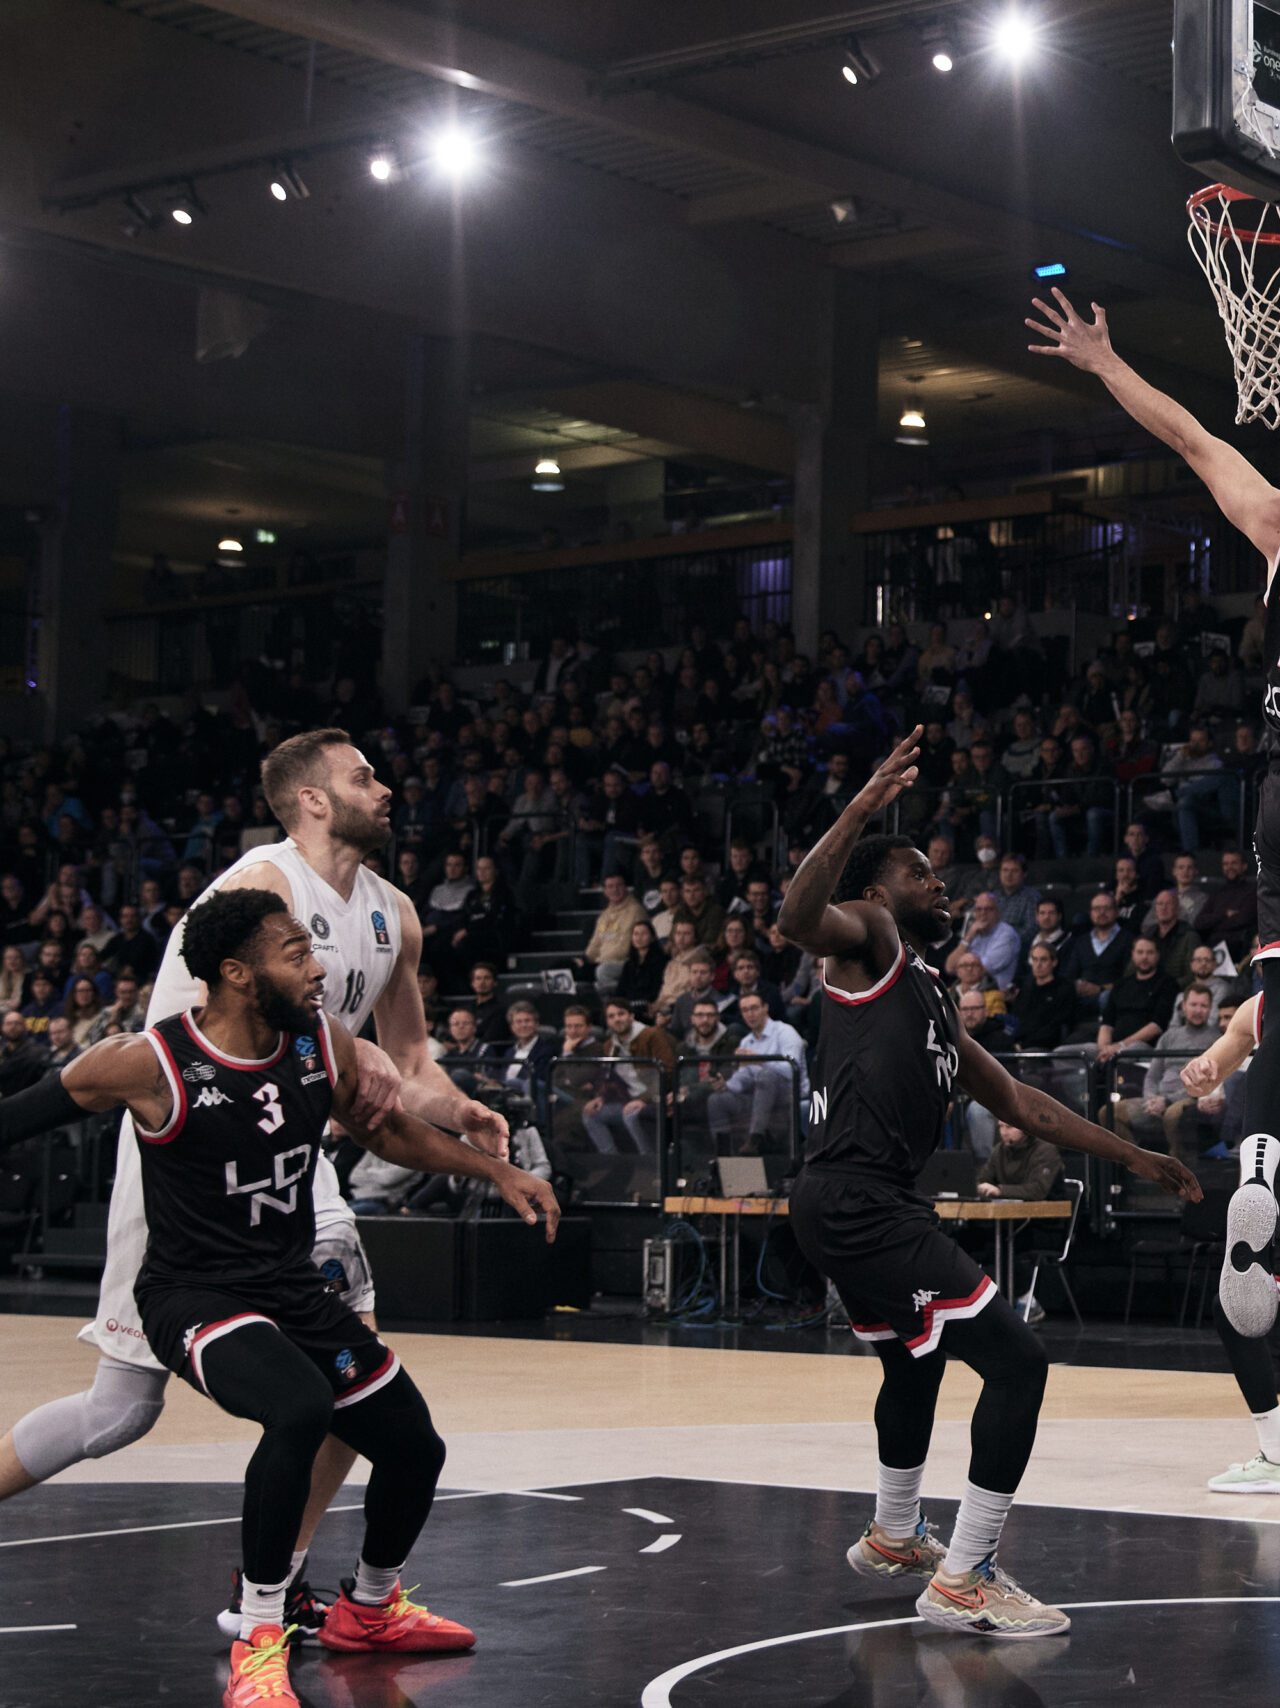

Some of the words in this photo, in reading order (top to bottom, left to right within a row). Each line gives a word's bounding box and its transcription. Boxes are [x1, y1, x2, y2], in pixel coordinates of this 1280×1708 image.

[340, 968, 365, 1014] 18
[252, 1081, 286, 1135] 3
[120, 1324, 148, 1341] VEOL
